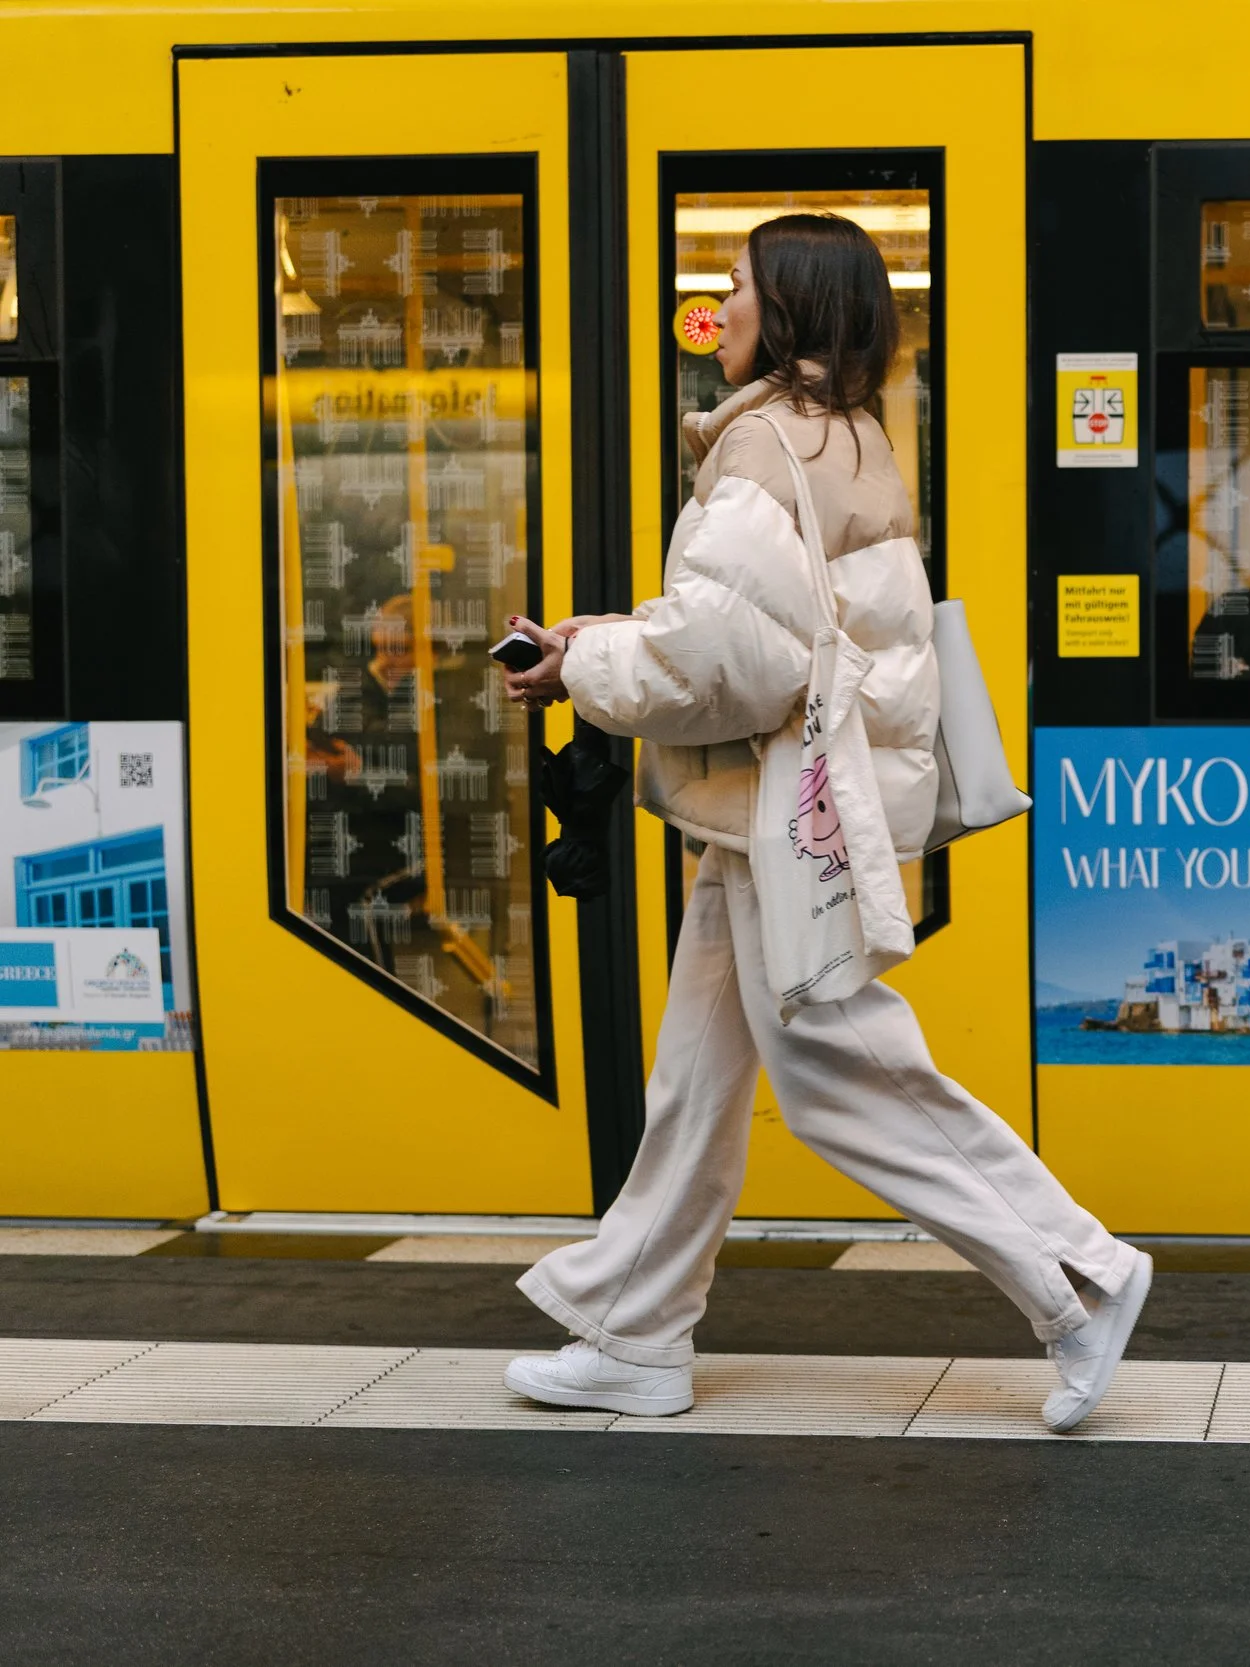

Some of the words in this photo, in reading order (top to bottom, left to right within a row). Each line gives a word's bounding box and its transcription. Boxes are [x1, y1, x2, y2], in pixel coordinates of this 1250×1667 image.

[1065, 586, 1107, 596] Mitfahrt
[1109, 587, 1126, 596] nur
[1065, 600, 1081, 609] mit
[1084, 600, 1129, 611] gültigem
[1065, 614, 1130, 624] Fahrausweis!
[1062, 847, 1166, 889] WHAT
